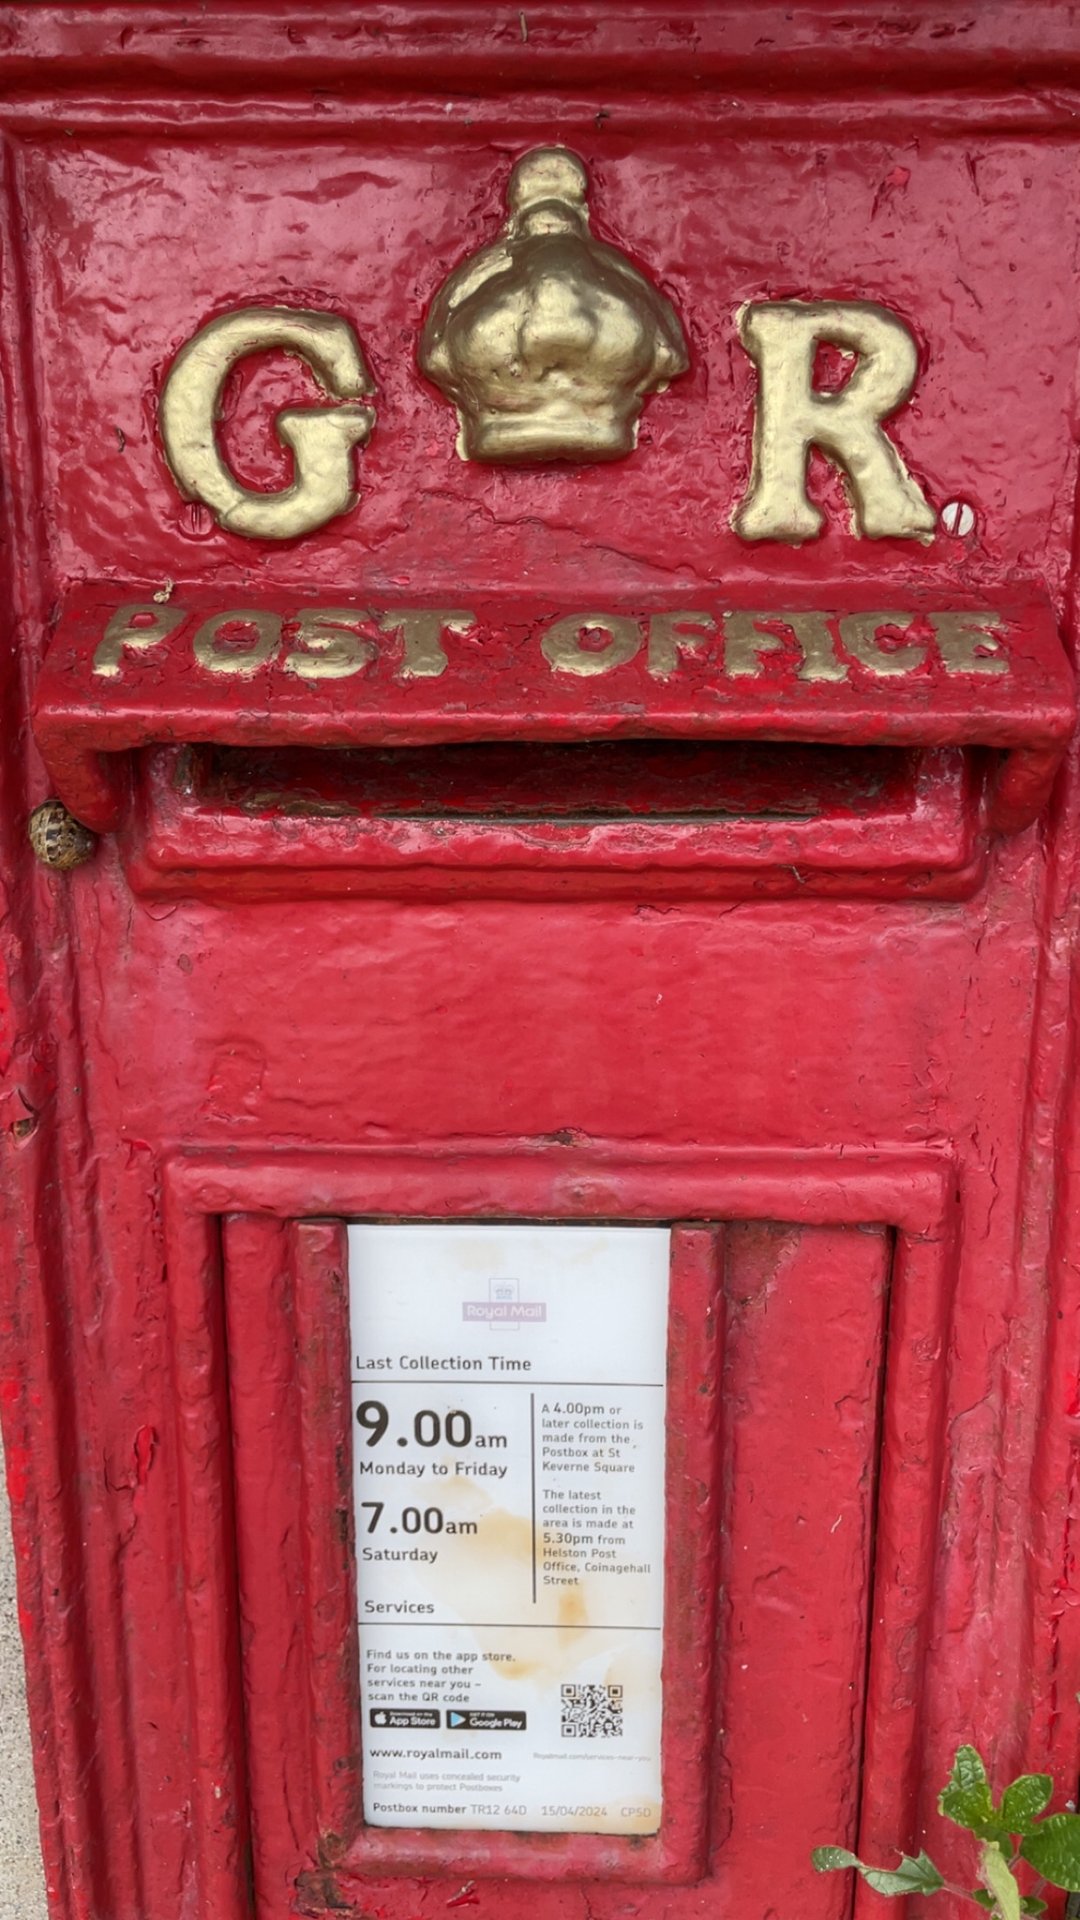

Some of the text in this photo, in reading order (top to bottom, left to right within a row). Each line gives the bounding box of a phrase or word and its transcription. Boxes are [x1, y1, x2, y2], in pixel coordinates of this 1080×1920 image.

[159, 299, 937, 545] G R
[92, 604, 1010, 683] POST OFFICE
[467, 1304, 542, 1319] Royal Mail
[356, 1355, 531, 1371] Last Collection Time
[542, 1403, 622, 1416] A 4.00pm or
[356, 1400, 507, 1448] 9.00am
[542, 1419, 644, 1430] later collection is
[543, 1433, 630, 1444] made from the
[543, 1447, 620, 1458] Postbox at St
[360, 1462, 508, 1478] Monday to Friday
[543, 1461, 635, 1474] Keverne Square
[543, 1490, 601, 1500] The latest
[543, 1504, 636, 1515] collection in the
[362, 1502, 478, 1534] 7.00am
[543, 1518, 634, 1529] area is made at
[544, 1532, 625, 1546] 5.30pm from
[362, 1548, 438, 1563] Saturday
[544, 1547, 616, 1558] Helston Post
[544, 1562, 651, 1575] Office, Coinagehall
[544, 1576, 579, 1586] Street
[365, 1600, 434, 1613] Services
[366, 1650, 516, 1663] Find us on the app store.
[367, 1664, 474, 1676] For locating other
[368, 1678, 415, 1687] services
[420, 1680, 446, 1688] near
[450, 1681, 470, 1690] you
[399, 1692, 418, 1700] the
[422, 1693, 438, 1702] QR
[443, 1694, 470, 1702] code
[390, 1716, 436, 1726] App Store
[470, 1718, 522, 1728] Google Play
[370, 1748, 502, 1760] www.royalmail.com
[374, 1771, 396, 1780] Royal
[442, 1772, 484, 1782] concealed
[487, 1774, 520, 1783] security
[374, 1782, 413, 1790] markings
[427, 1784, 456, 1792] protect
[460, 1784, 502, 1792] Postboxes
[374, 1803, 418, 1812] Postbox
[422, 1805, 466, 1814] number
[470, 1805, 500, 1815] TR12
[504, 1806, 526, 1816] 64D
[542, 1806, 608, 1816] 15/04/2024
